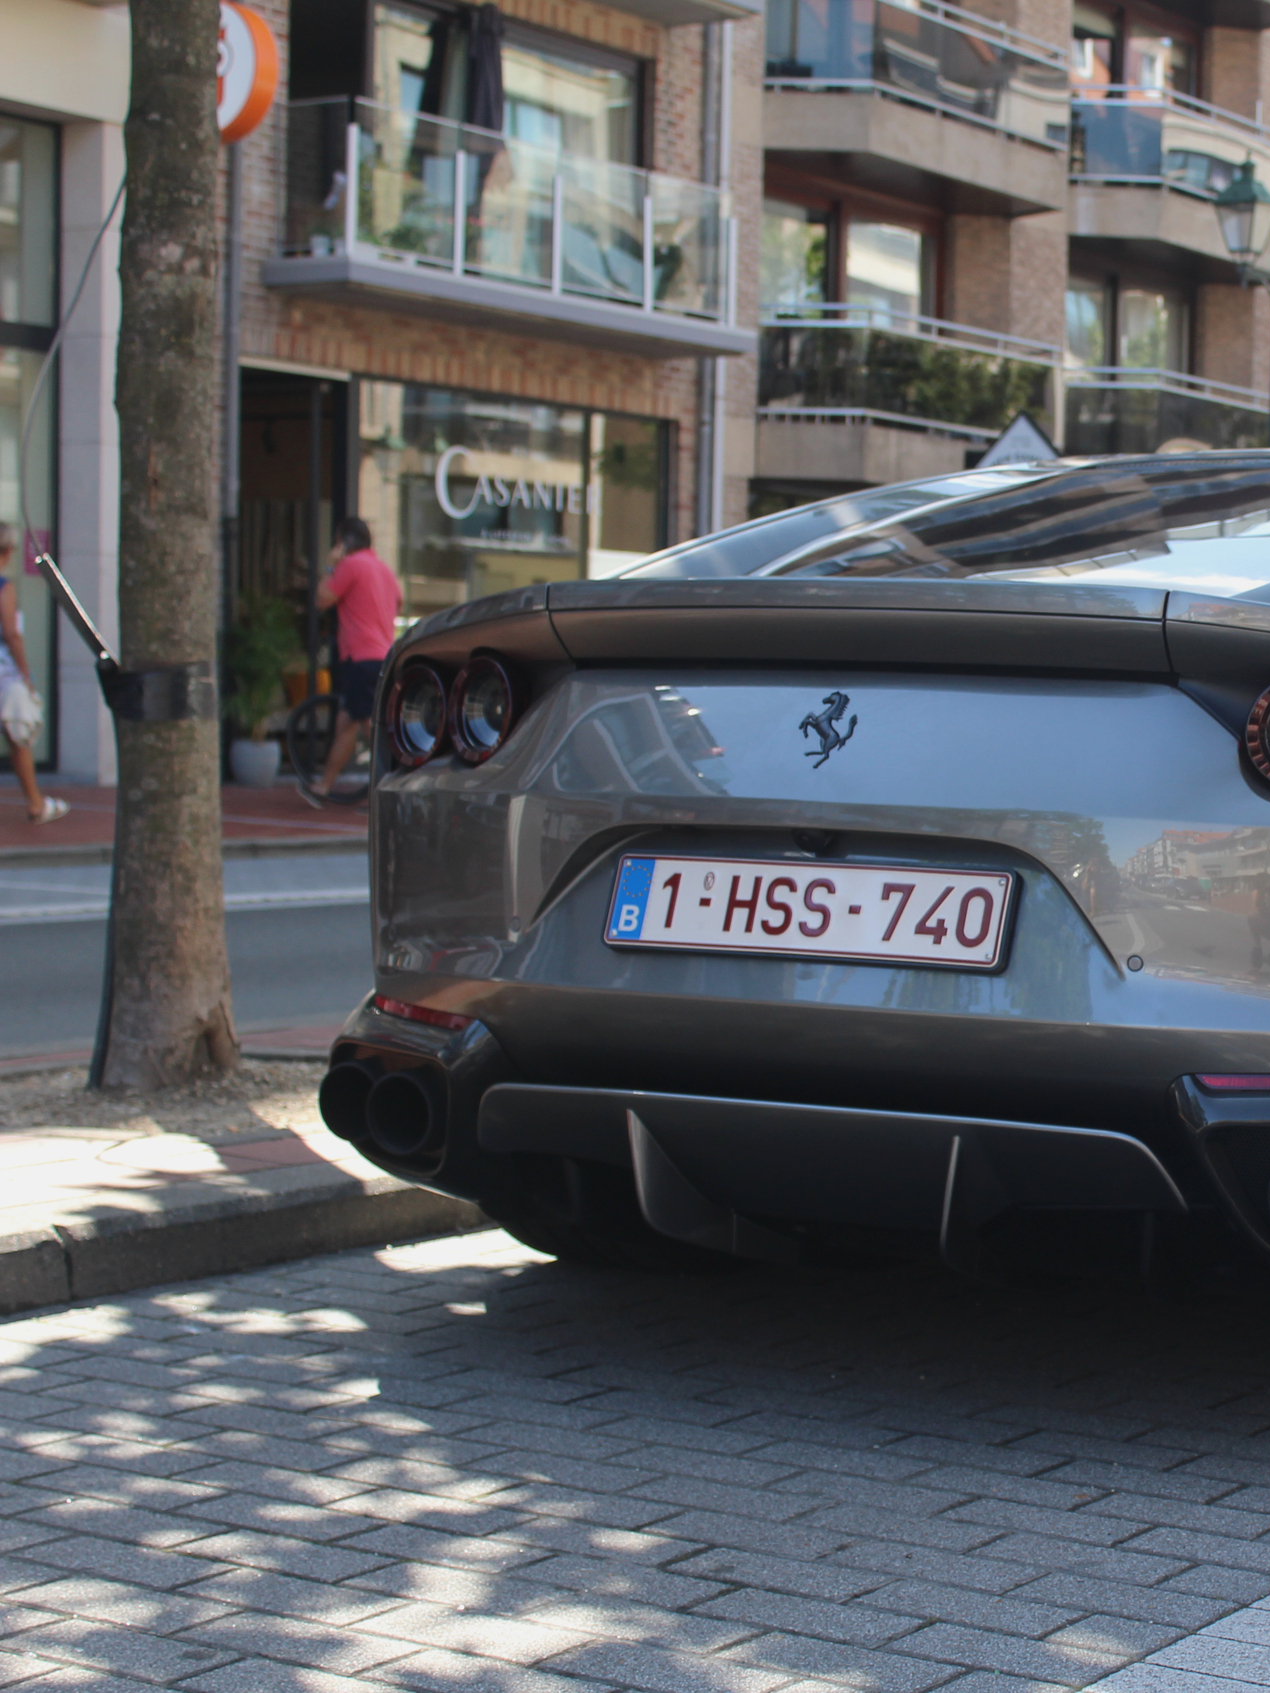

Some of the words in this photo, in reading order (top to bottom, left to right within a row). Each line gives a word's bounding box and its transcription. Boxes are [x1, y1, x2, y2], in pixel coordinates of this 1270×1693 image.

[435, 445, 603, 520] CASANIE
[617, 905, 640, 932] B
[661, 871, 994, 949] 1-HSS-740
